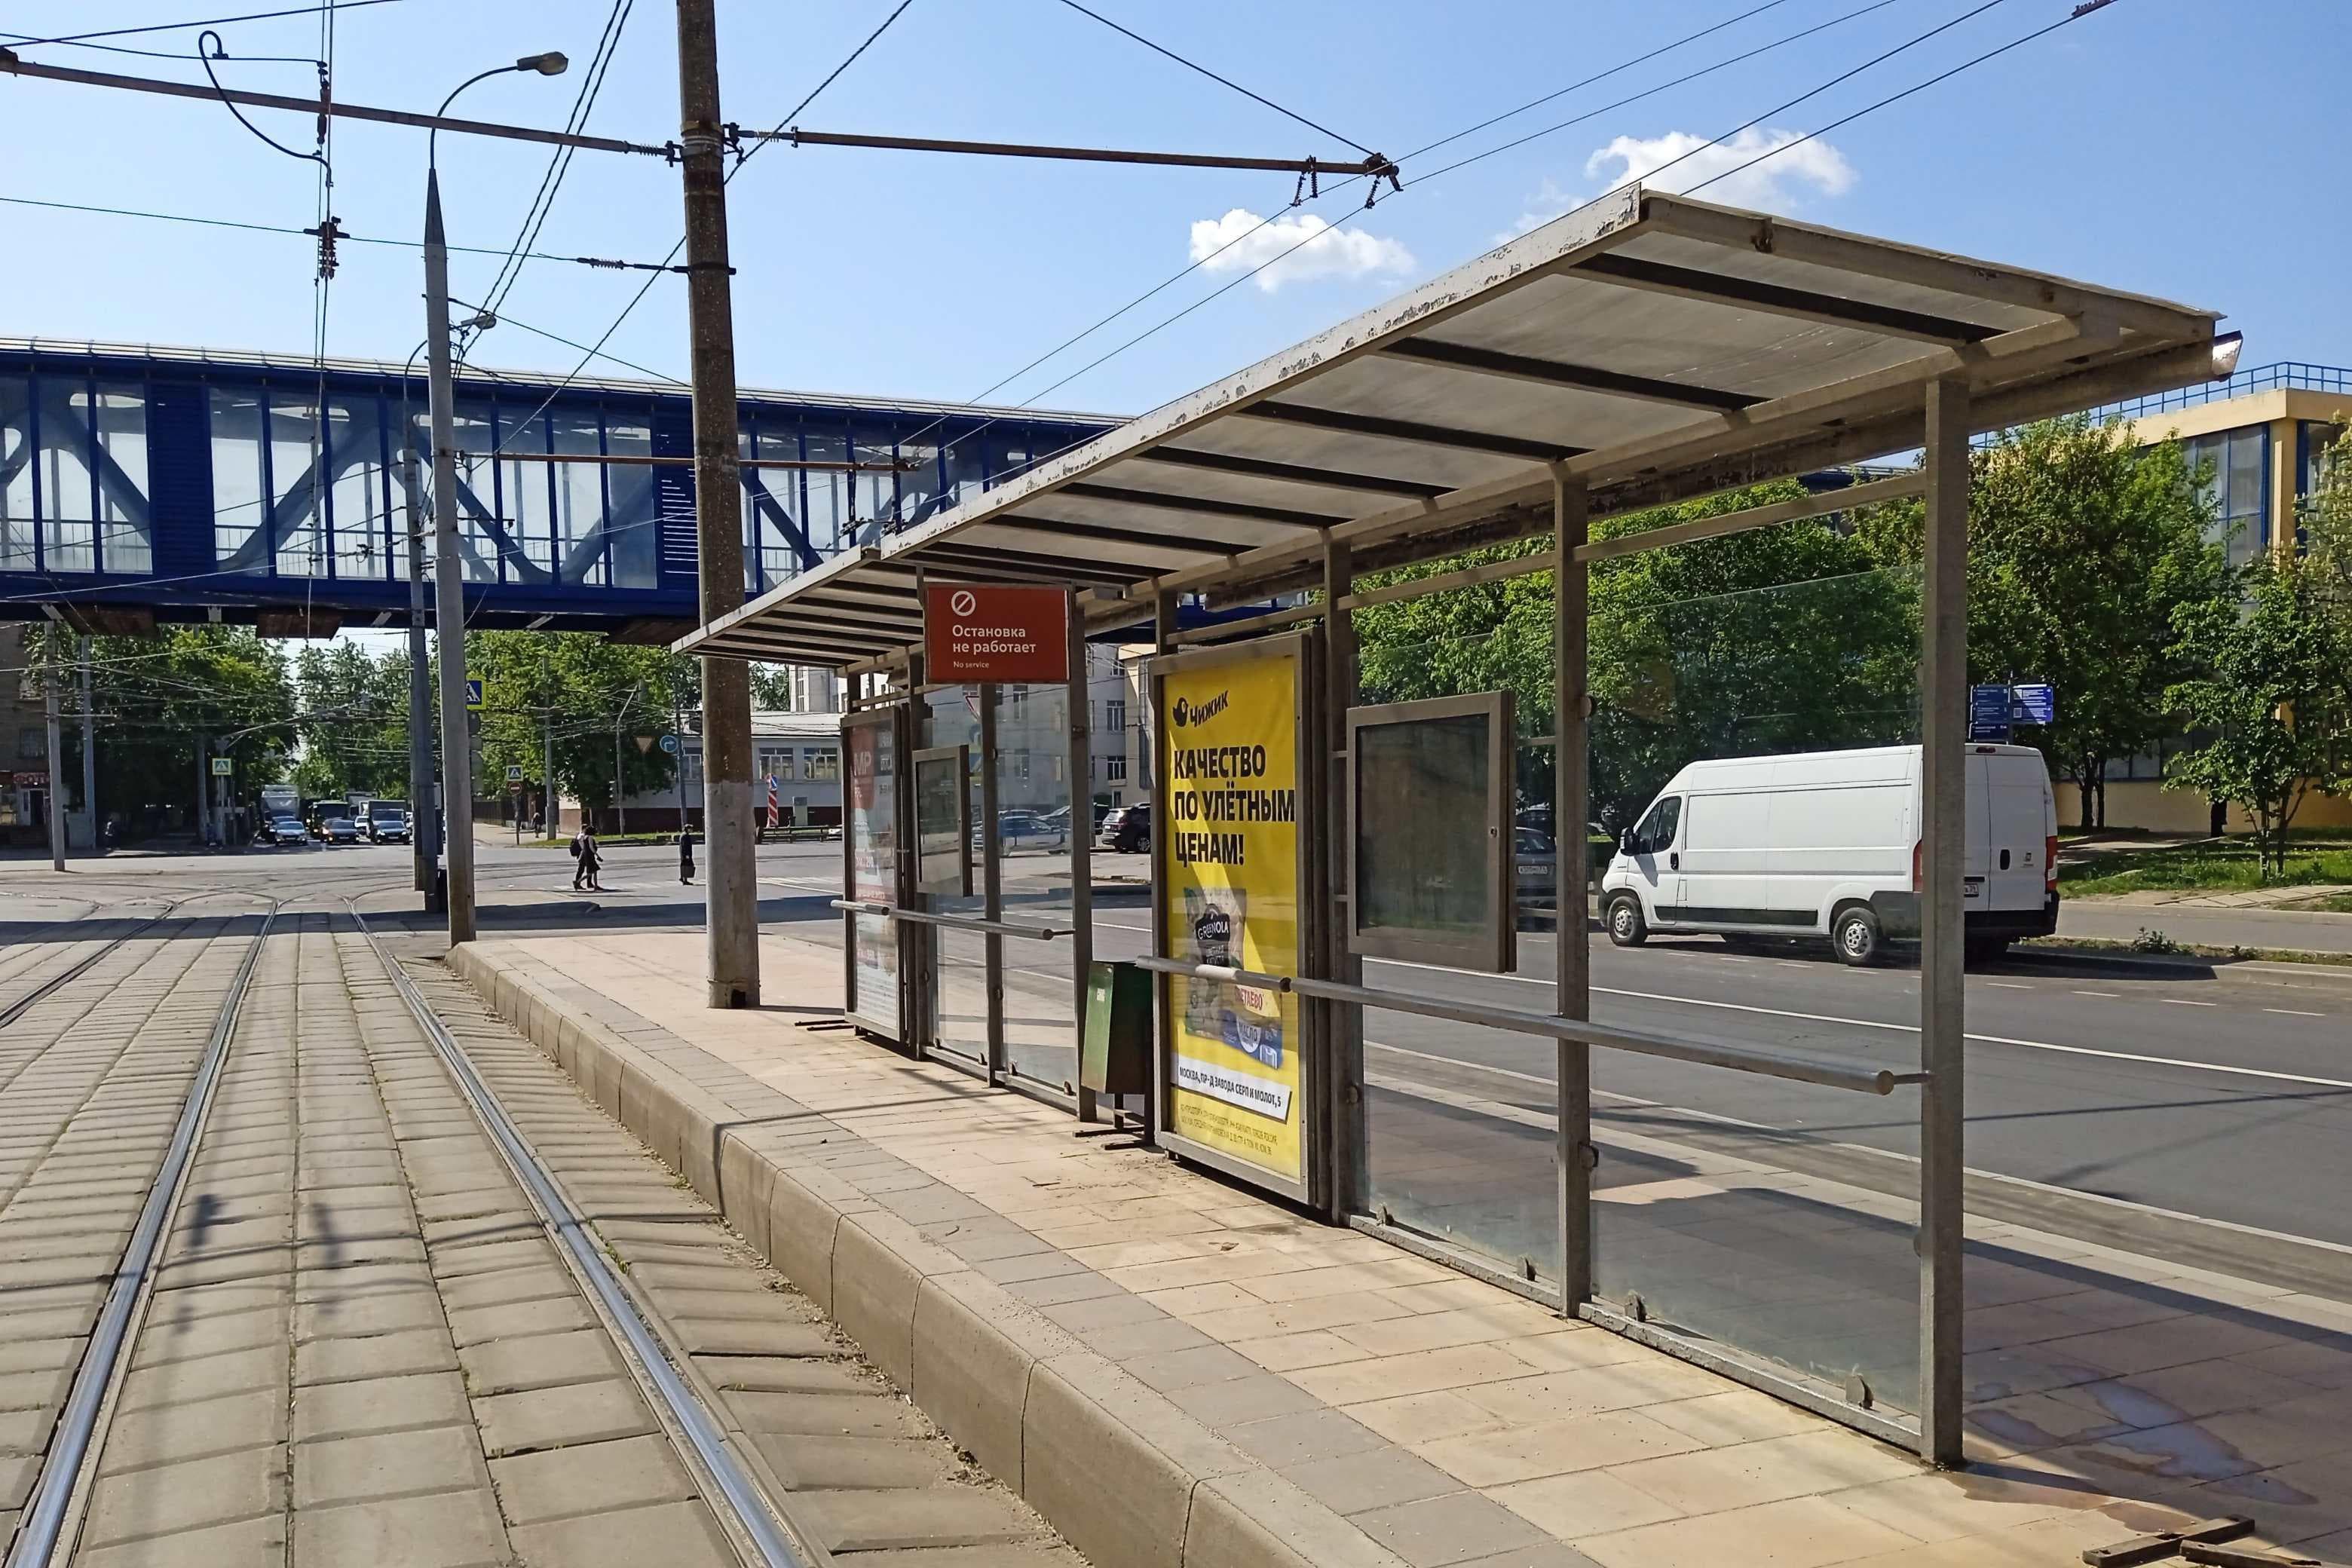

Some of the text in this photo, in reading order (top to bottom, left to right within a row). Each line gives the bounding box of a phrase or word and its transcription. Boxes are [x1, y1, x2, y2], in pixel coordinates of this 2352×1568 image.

[952, 624, 1026, 638] Остановка
[953, 640, 1036, 655] не работает
[1190, 690, 1229, 727] ЧИЖИК
[1174, 745, 1266, 779] КАЧЕСТВО
[1174, 780, 1295, 822] ПО УЛЁТНЫМ
[1175, 832, 1244, 868] ЦЕНАМ!
[1198, 921, 1230, 939] GREENOLA
[1179, 1067, 1201, 1084] МОСКВА,
[1214, 1076, 1235, 1092] ЗАВОДА
[1236, 1083, 1249, 1098] СЕРП
[1254, 1089, 1277, 1108] МОЛОТ,
[1277, 1095, 1282, 1107] 5
